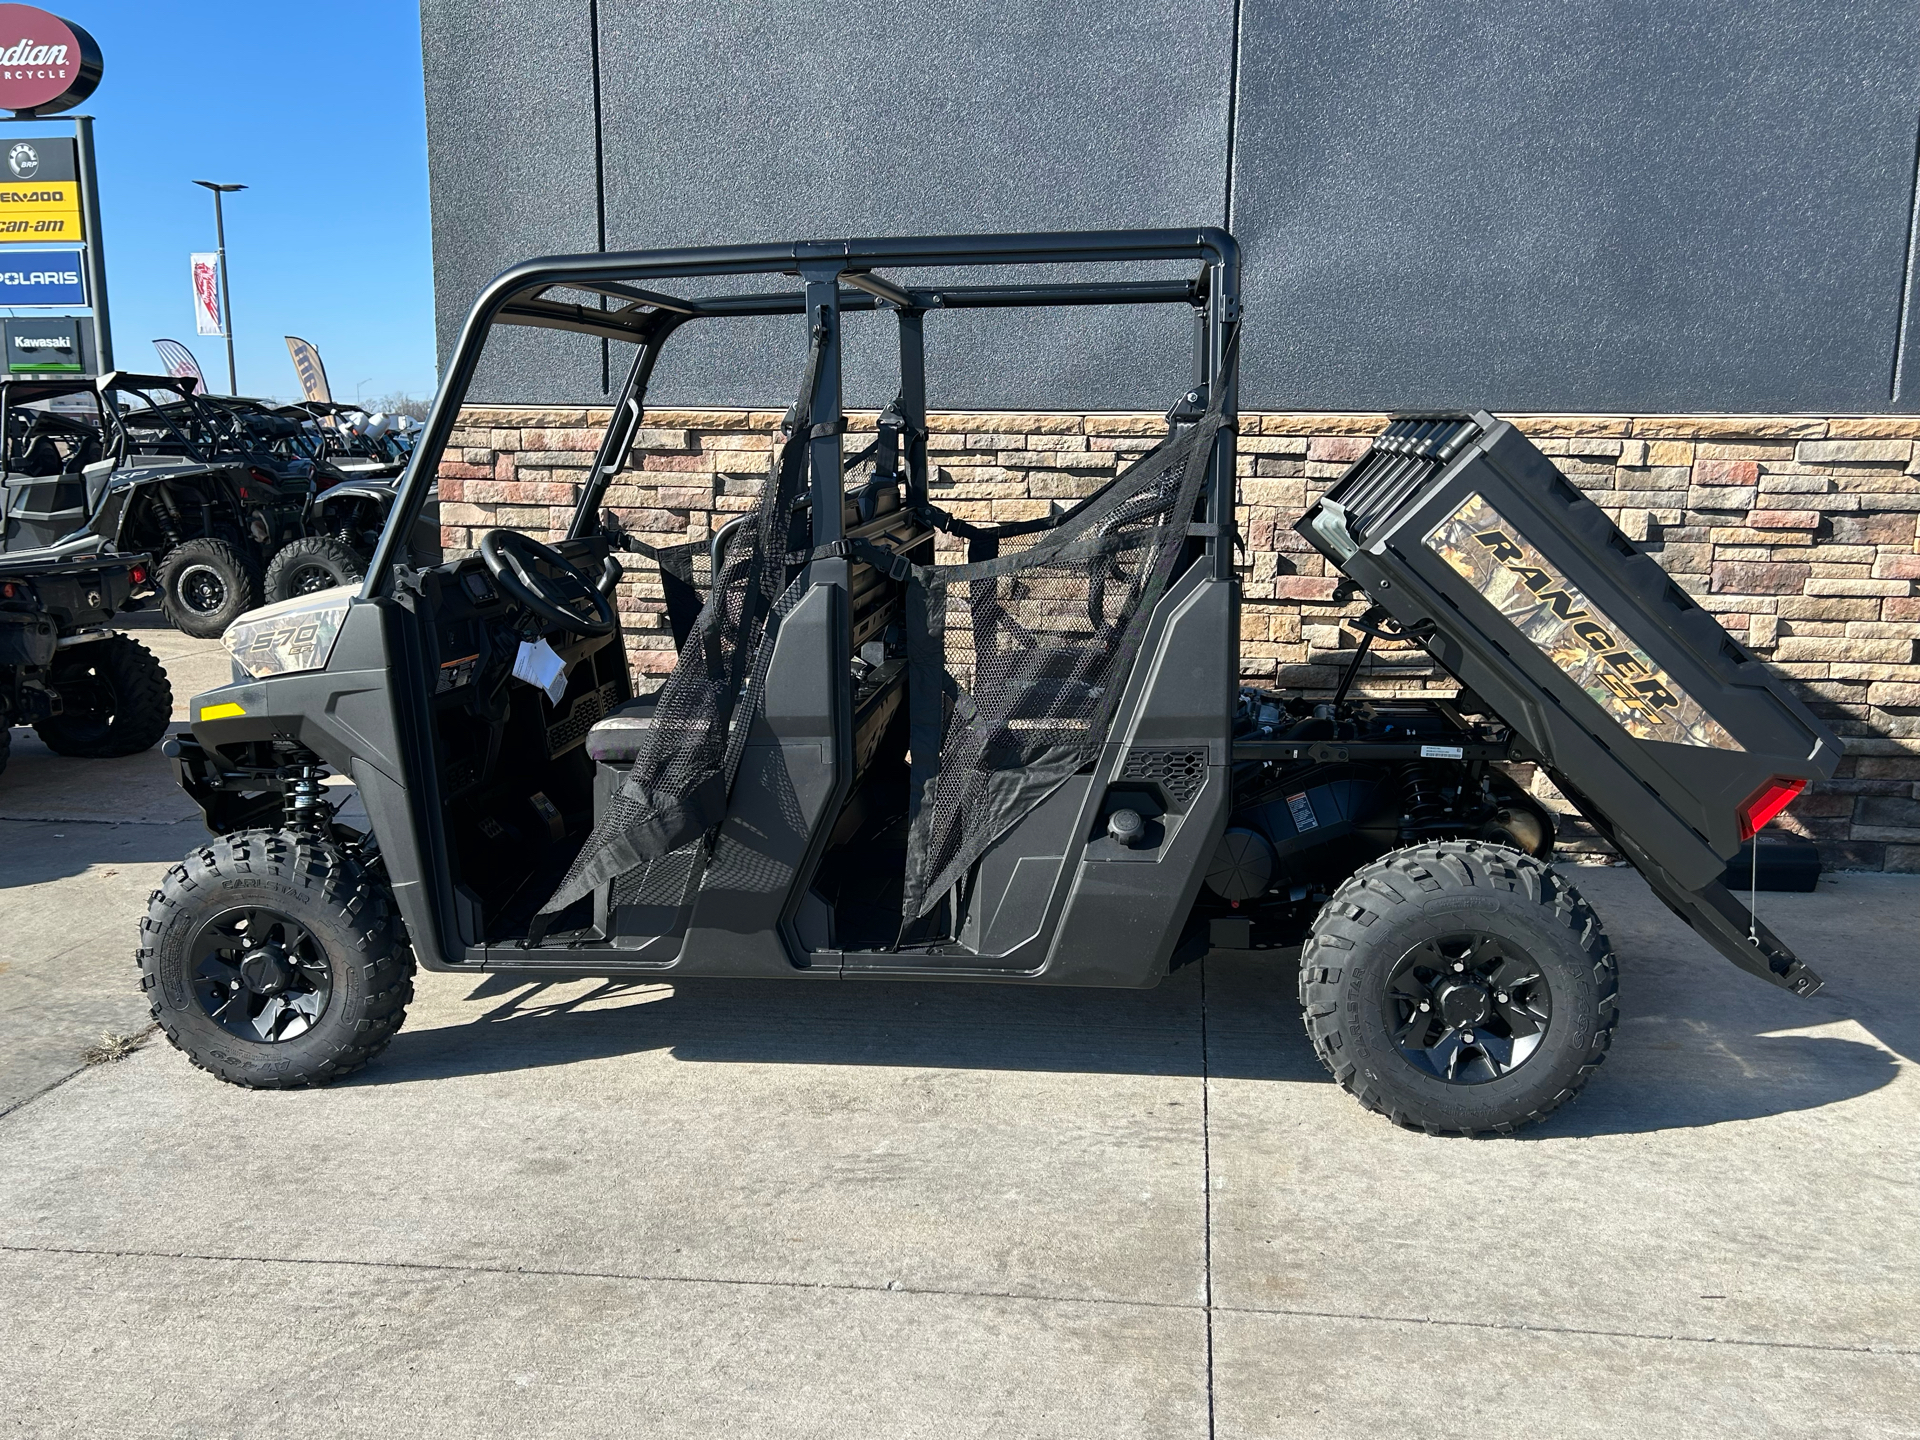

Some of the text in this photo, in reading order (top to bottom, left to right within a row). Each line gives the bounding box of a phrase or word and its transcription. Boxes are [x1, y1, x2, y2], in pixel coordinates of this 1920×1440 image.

[15, 336, 71, 348] Kawasaki
[1471, 529, 1681, 713] RANGER
[250, 623, 319, 653] 570
[288, 643, 315, 656] EFI
[1594, 673, 1667, 725] SP
[221, 878, 311, 906] CARLSTAR
[1346, 966, 1371, 1060] CARLSTAR
[209, 1048, 292, 1073] AT489
